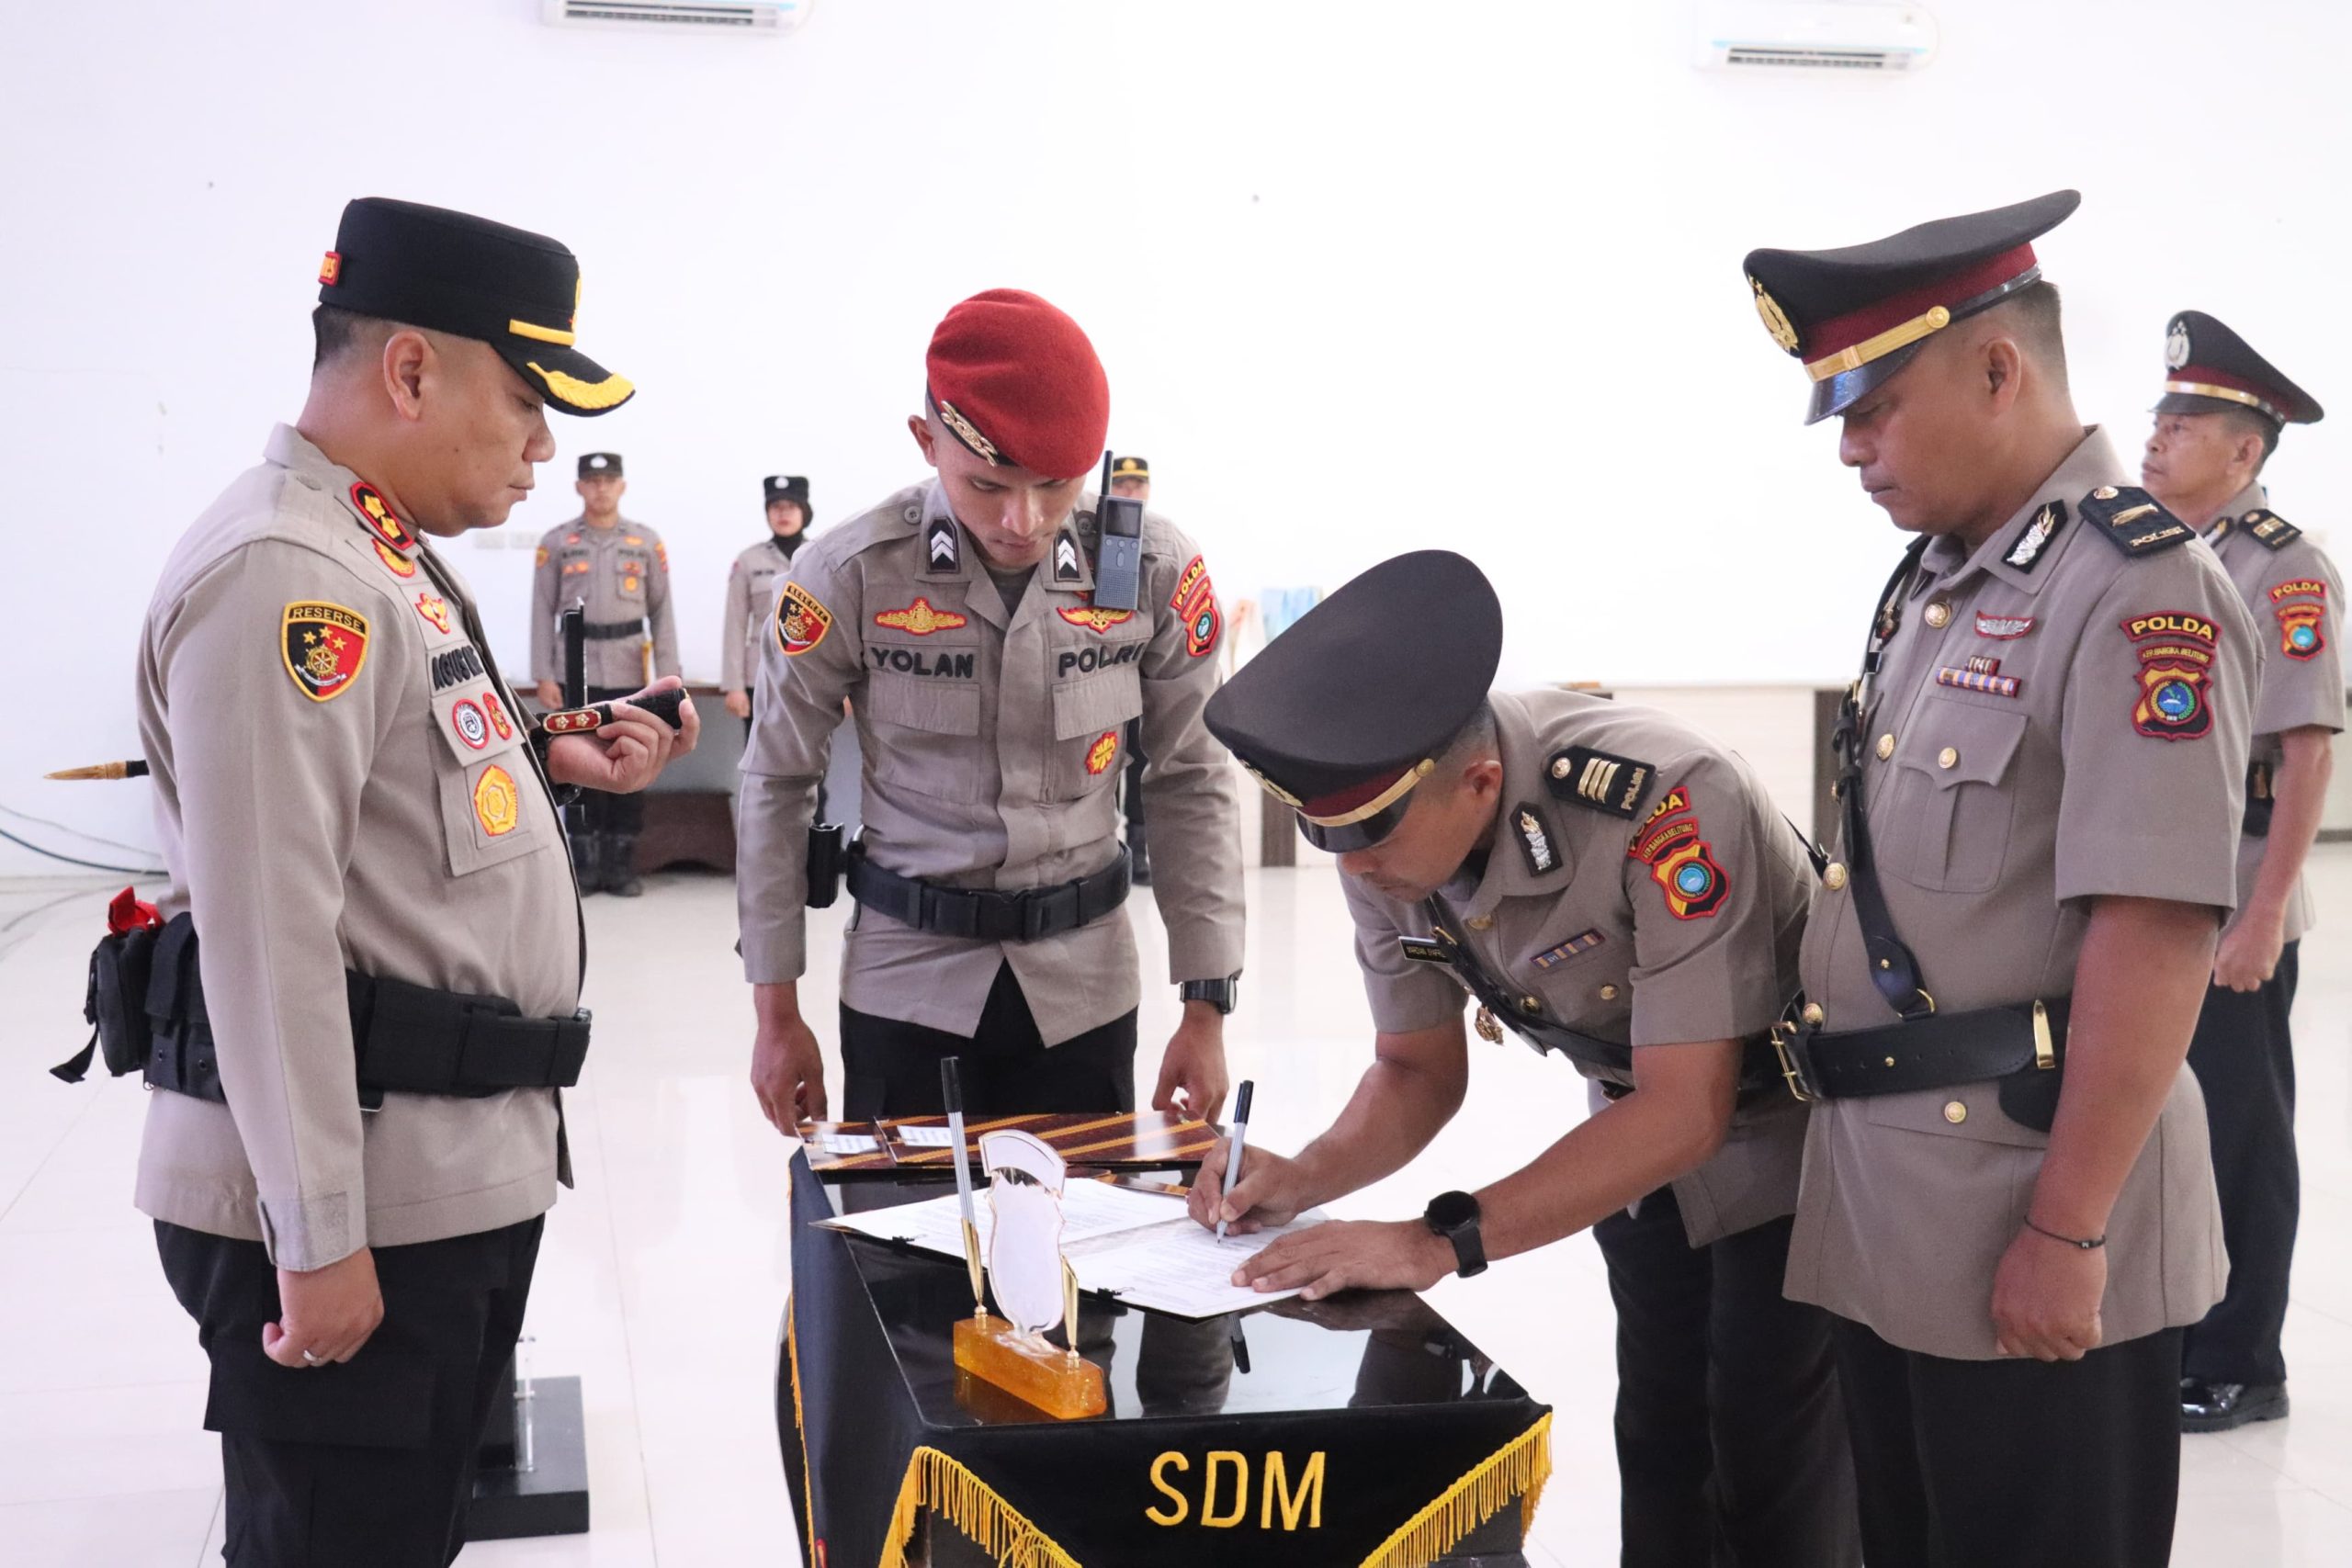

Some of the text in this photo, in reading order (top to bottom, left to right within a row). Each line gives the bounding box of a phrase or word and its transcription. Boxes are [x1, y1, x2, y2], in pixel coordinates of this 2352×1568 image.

[1176, 560, 1205, 606] POLDA
[2273, 581, 2322, 598] POLDA
[293, 607, 362, 632] RESERSE
[2132, 616, 2212, 640] POLDA
[871, 647, 974, 679] YOLAN
[1058, 642, 1145, 678] POLRI
[1145, 1450, 1326, 1531] SDM
